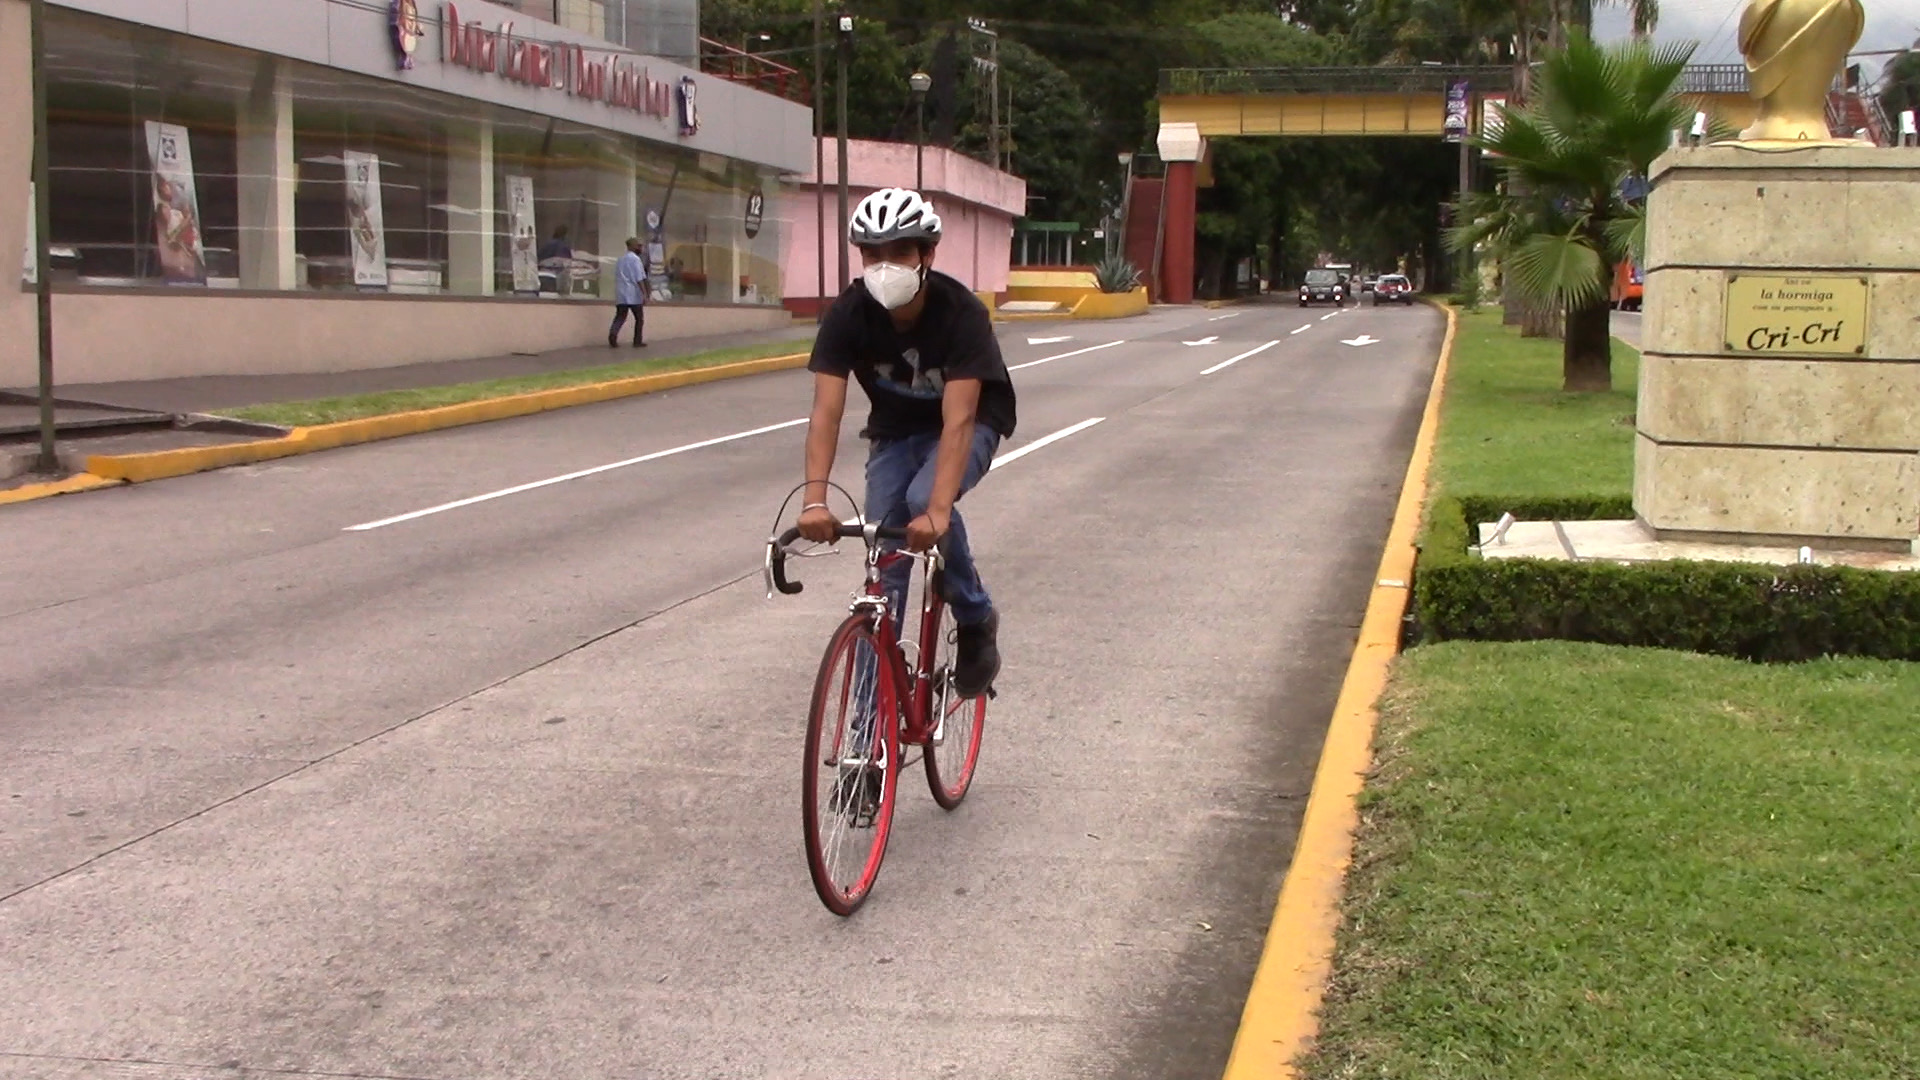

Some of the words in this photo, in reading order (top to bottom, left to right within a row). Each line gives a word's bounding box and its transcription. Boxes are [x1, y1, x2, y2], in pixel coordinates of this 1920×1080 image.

[750, 195, 761, 215] 12
[1761, 289, 1773, 299] la
[1777, 289, 1833, 303] hormiga
[1747, 320, 1844, 350] Cri-Crí
